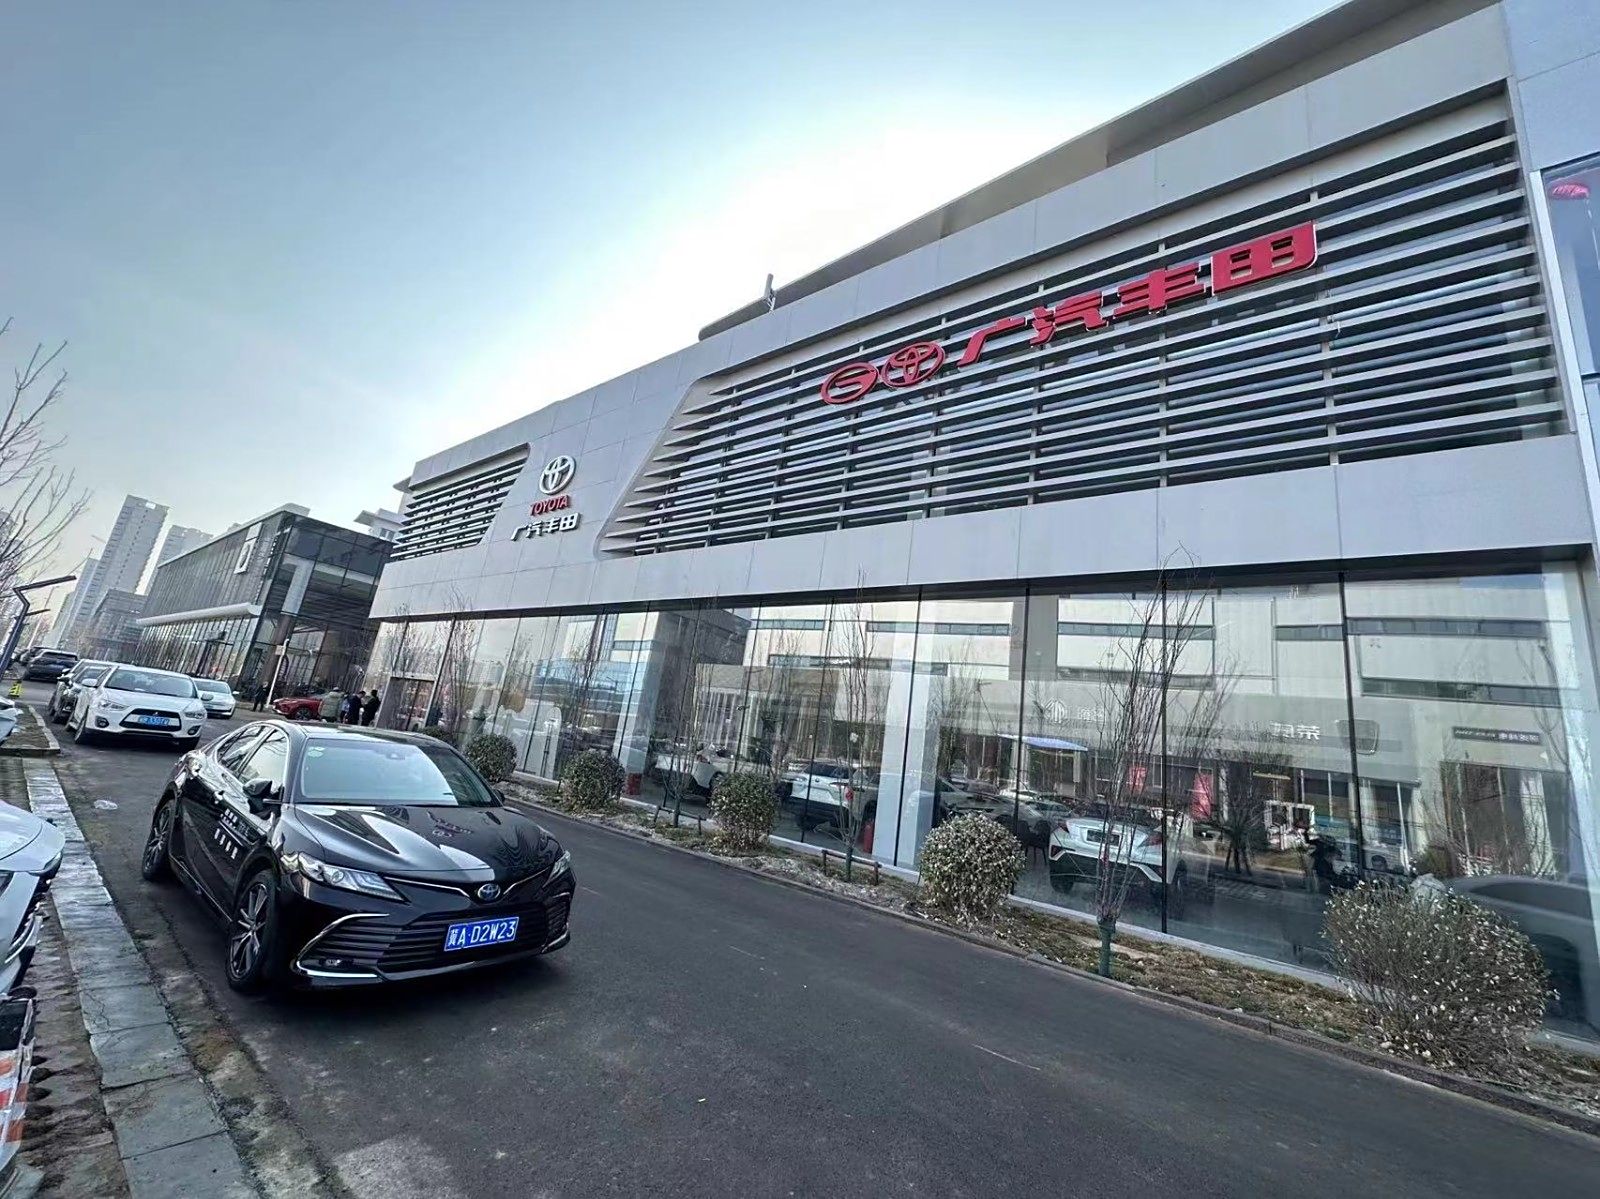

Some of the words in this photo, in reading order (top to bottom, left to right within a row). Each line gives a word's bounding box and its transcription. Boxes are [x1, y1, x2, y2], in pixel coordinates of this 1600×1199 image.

[957, 220, 1318, 367] 广汽丰田
[529, 495, 570, 517] TOYOTA
[510, 512, 581, 541] 广汽丰田
